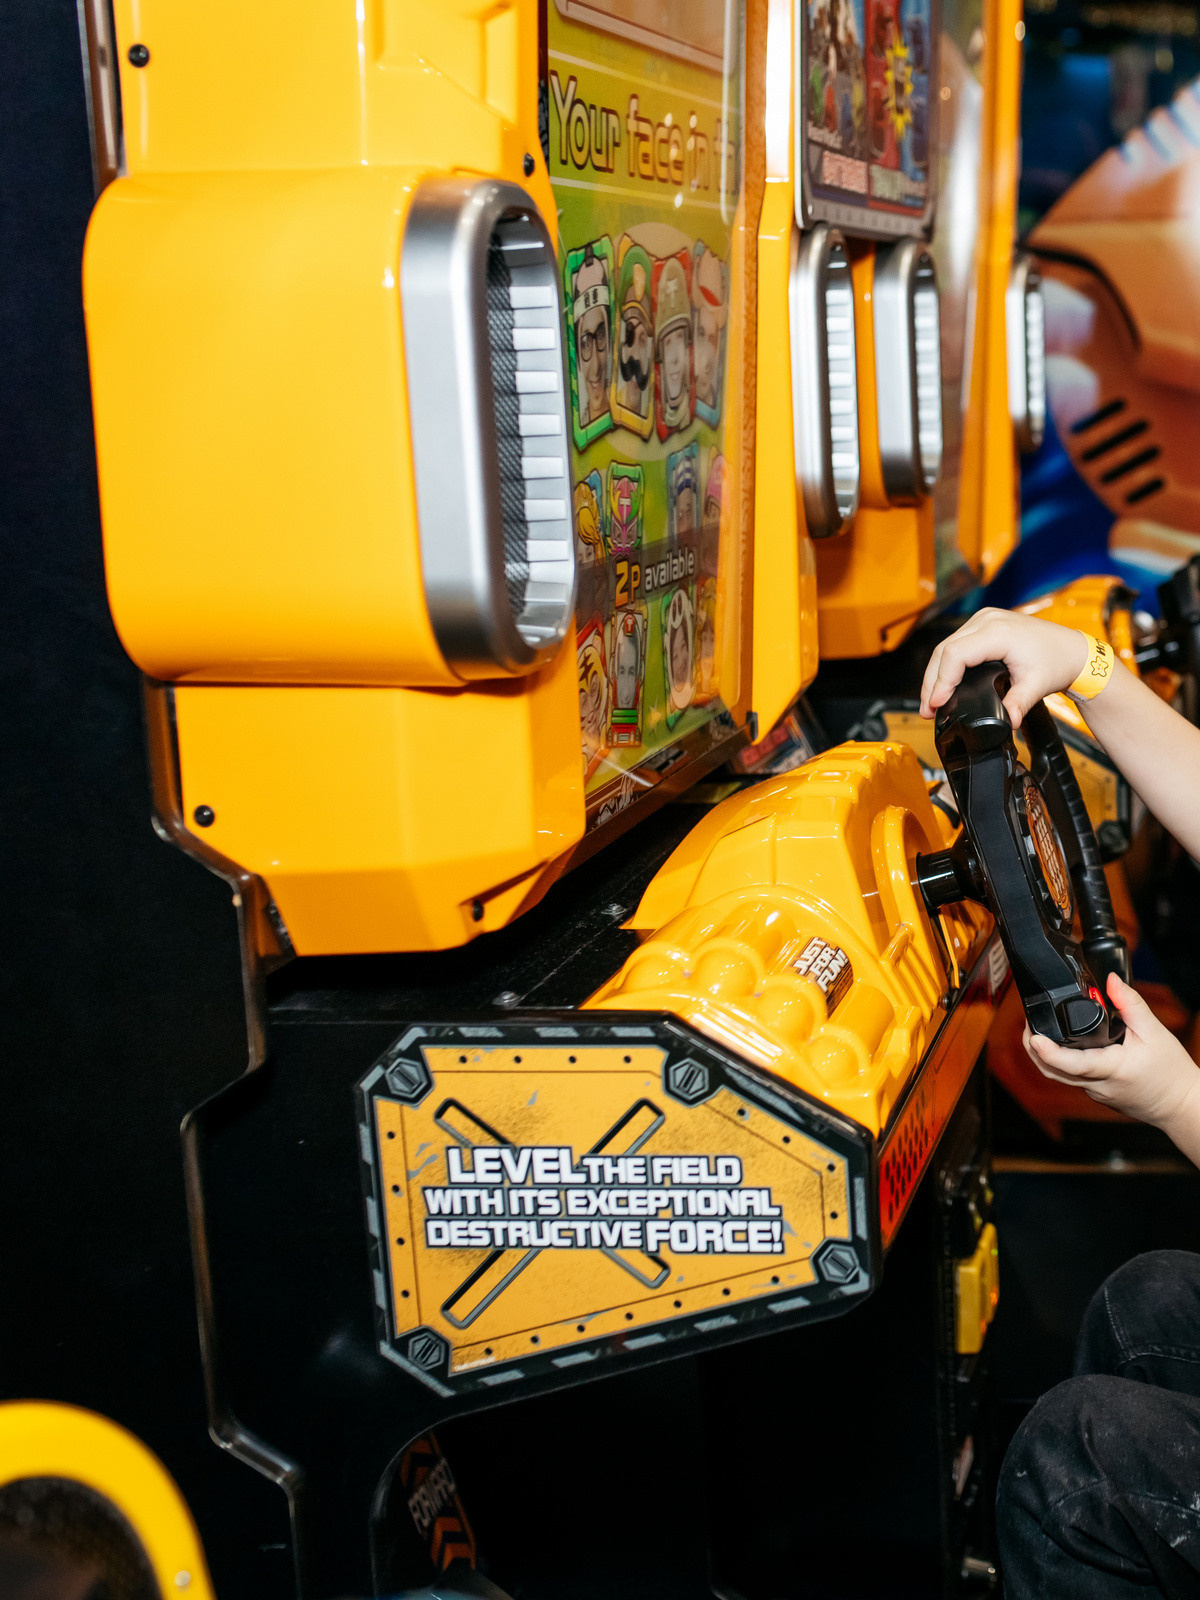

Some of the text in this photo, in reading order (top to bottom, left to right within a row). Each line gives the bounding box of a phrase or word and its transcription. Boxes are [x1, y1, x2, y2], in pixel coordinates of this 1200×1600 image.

[550, 70, 621, 174] Your
[626, 94, 685, 186] face
[615, 547, 695, 607] 2P available
[793, 936, 828, 976] JUST
[809, 946, 837, 976] FOR
[816, 948, 849, 992] FUN!
[447, 1147, 742, 1185] LEVEL THE FIELD
[424, 1188, 782, 1216] WITH ITS EXCEPTIONAL
[426, 1219, 784, 1253] DESTRUCTIVE FORCE!
